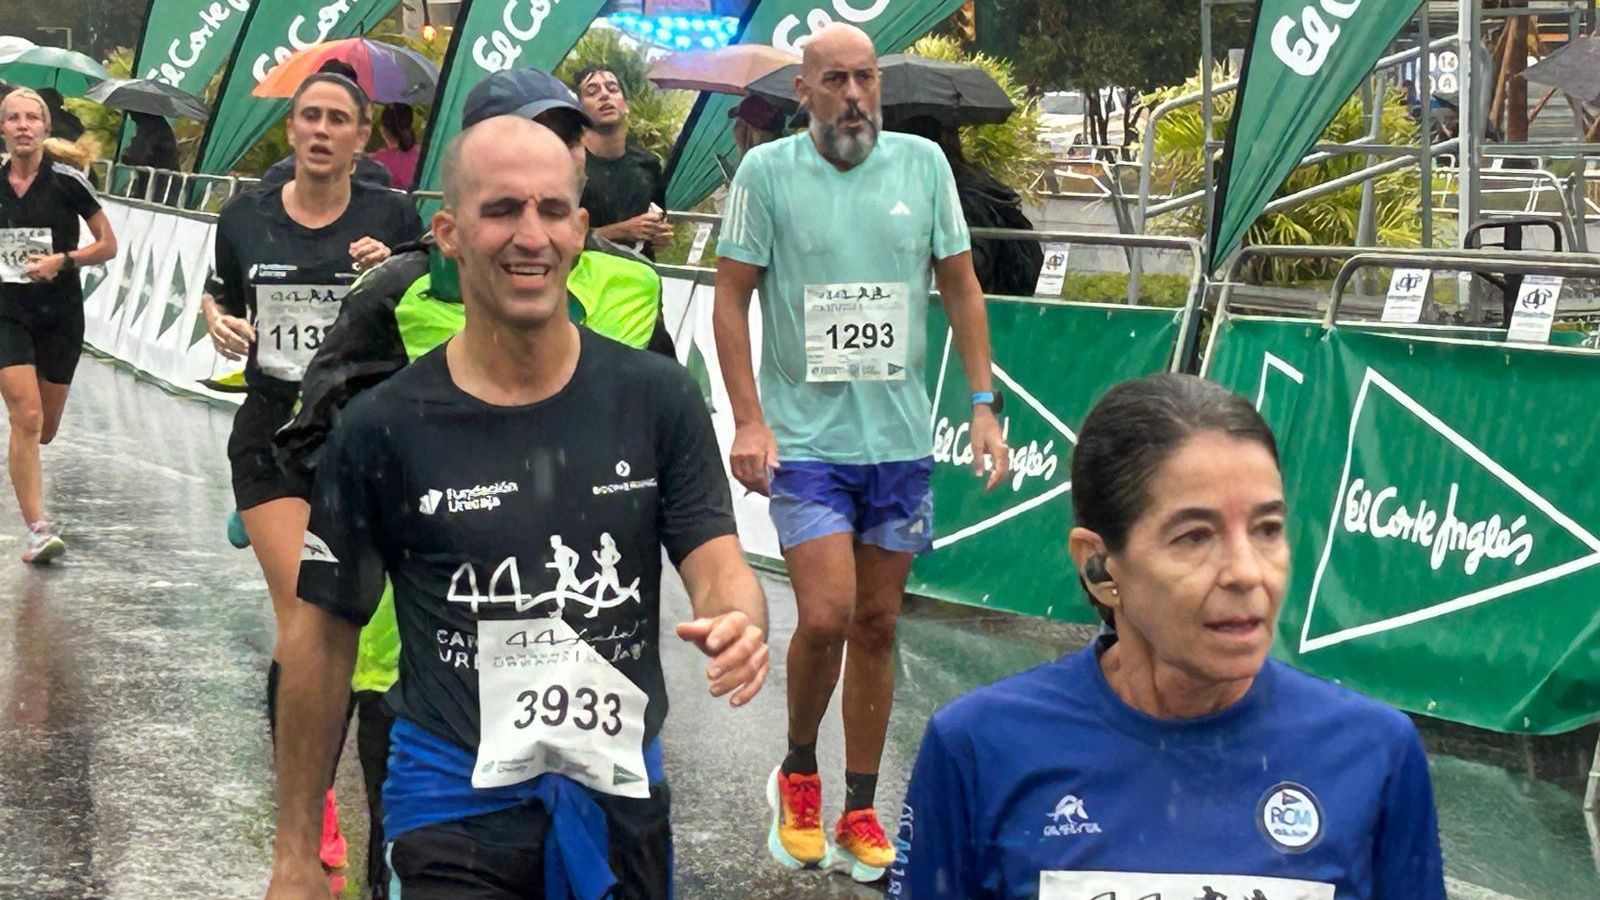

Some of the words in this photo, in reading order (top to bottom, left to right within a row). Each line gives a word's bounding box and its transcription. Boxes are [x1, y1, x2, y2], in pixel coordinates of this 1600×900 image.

[168, 2, 230, 68] Corte
[472, 30, 522, 73] El
[1270, 5, 1340, 76] El
[825, 322, 895, 349] 1293
[1344, 478, 1372, 533] El
[1369, 486, 1437, 547] Corte
[1430, 482, 1533, 575] Inglés
[514, 684, 622, 737] 3933
